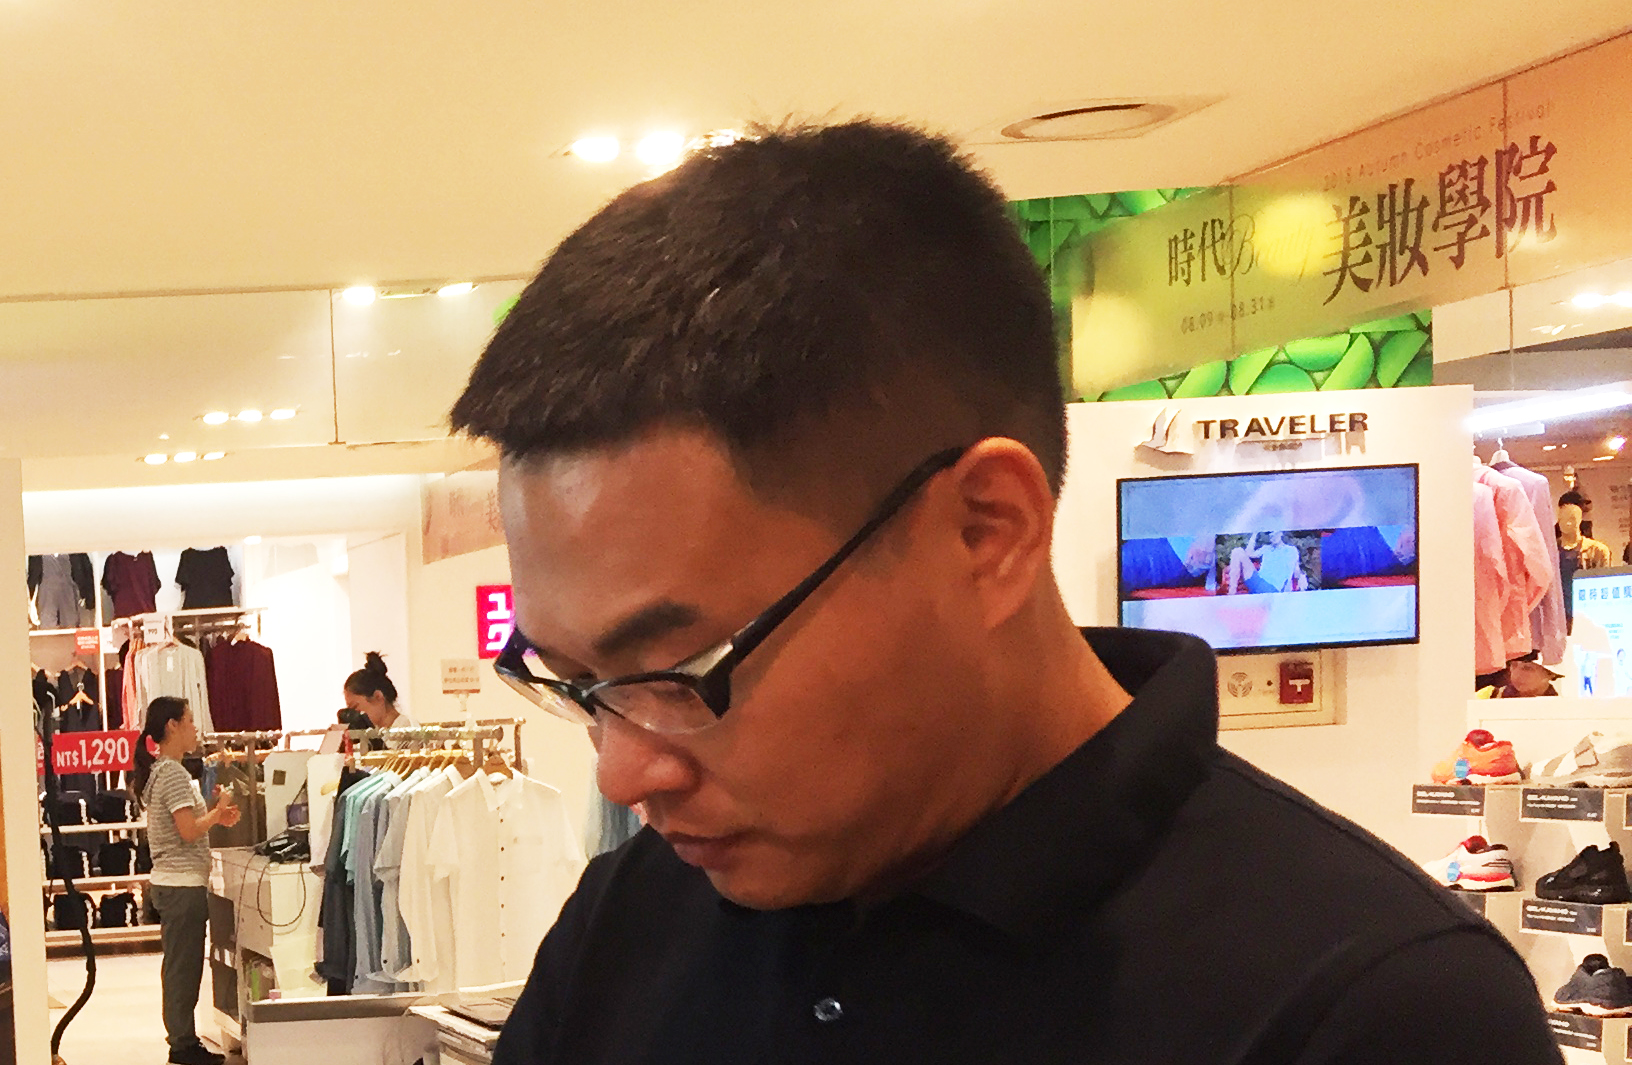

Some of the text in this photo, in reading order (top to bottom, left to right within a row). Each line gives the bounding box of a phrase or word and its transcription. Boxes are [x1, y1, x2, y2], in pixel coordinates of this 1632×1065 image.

[1168, 217, 1227, 287] 時代
[1323, 135, 1558, 306] 美妝學院
[1196, 412, 1369, 440] TRAVELER
[56, 736, 130, 769] NT$1,290
